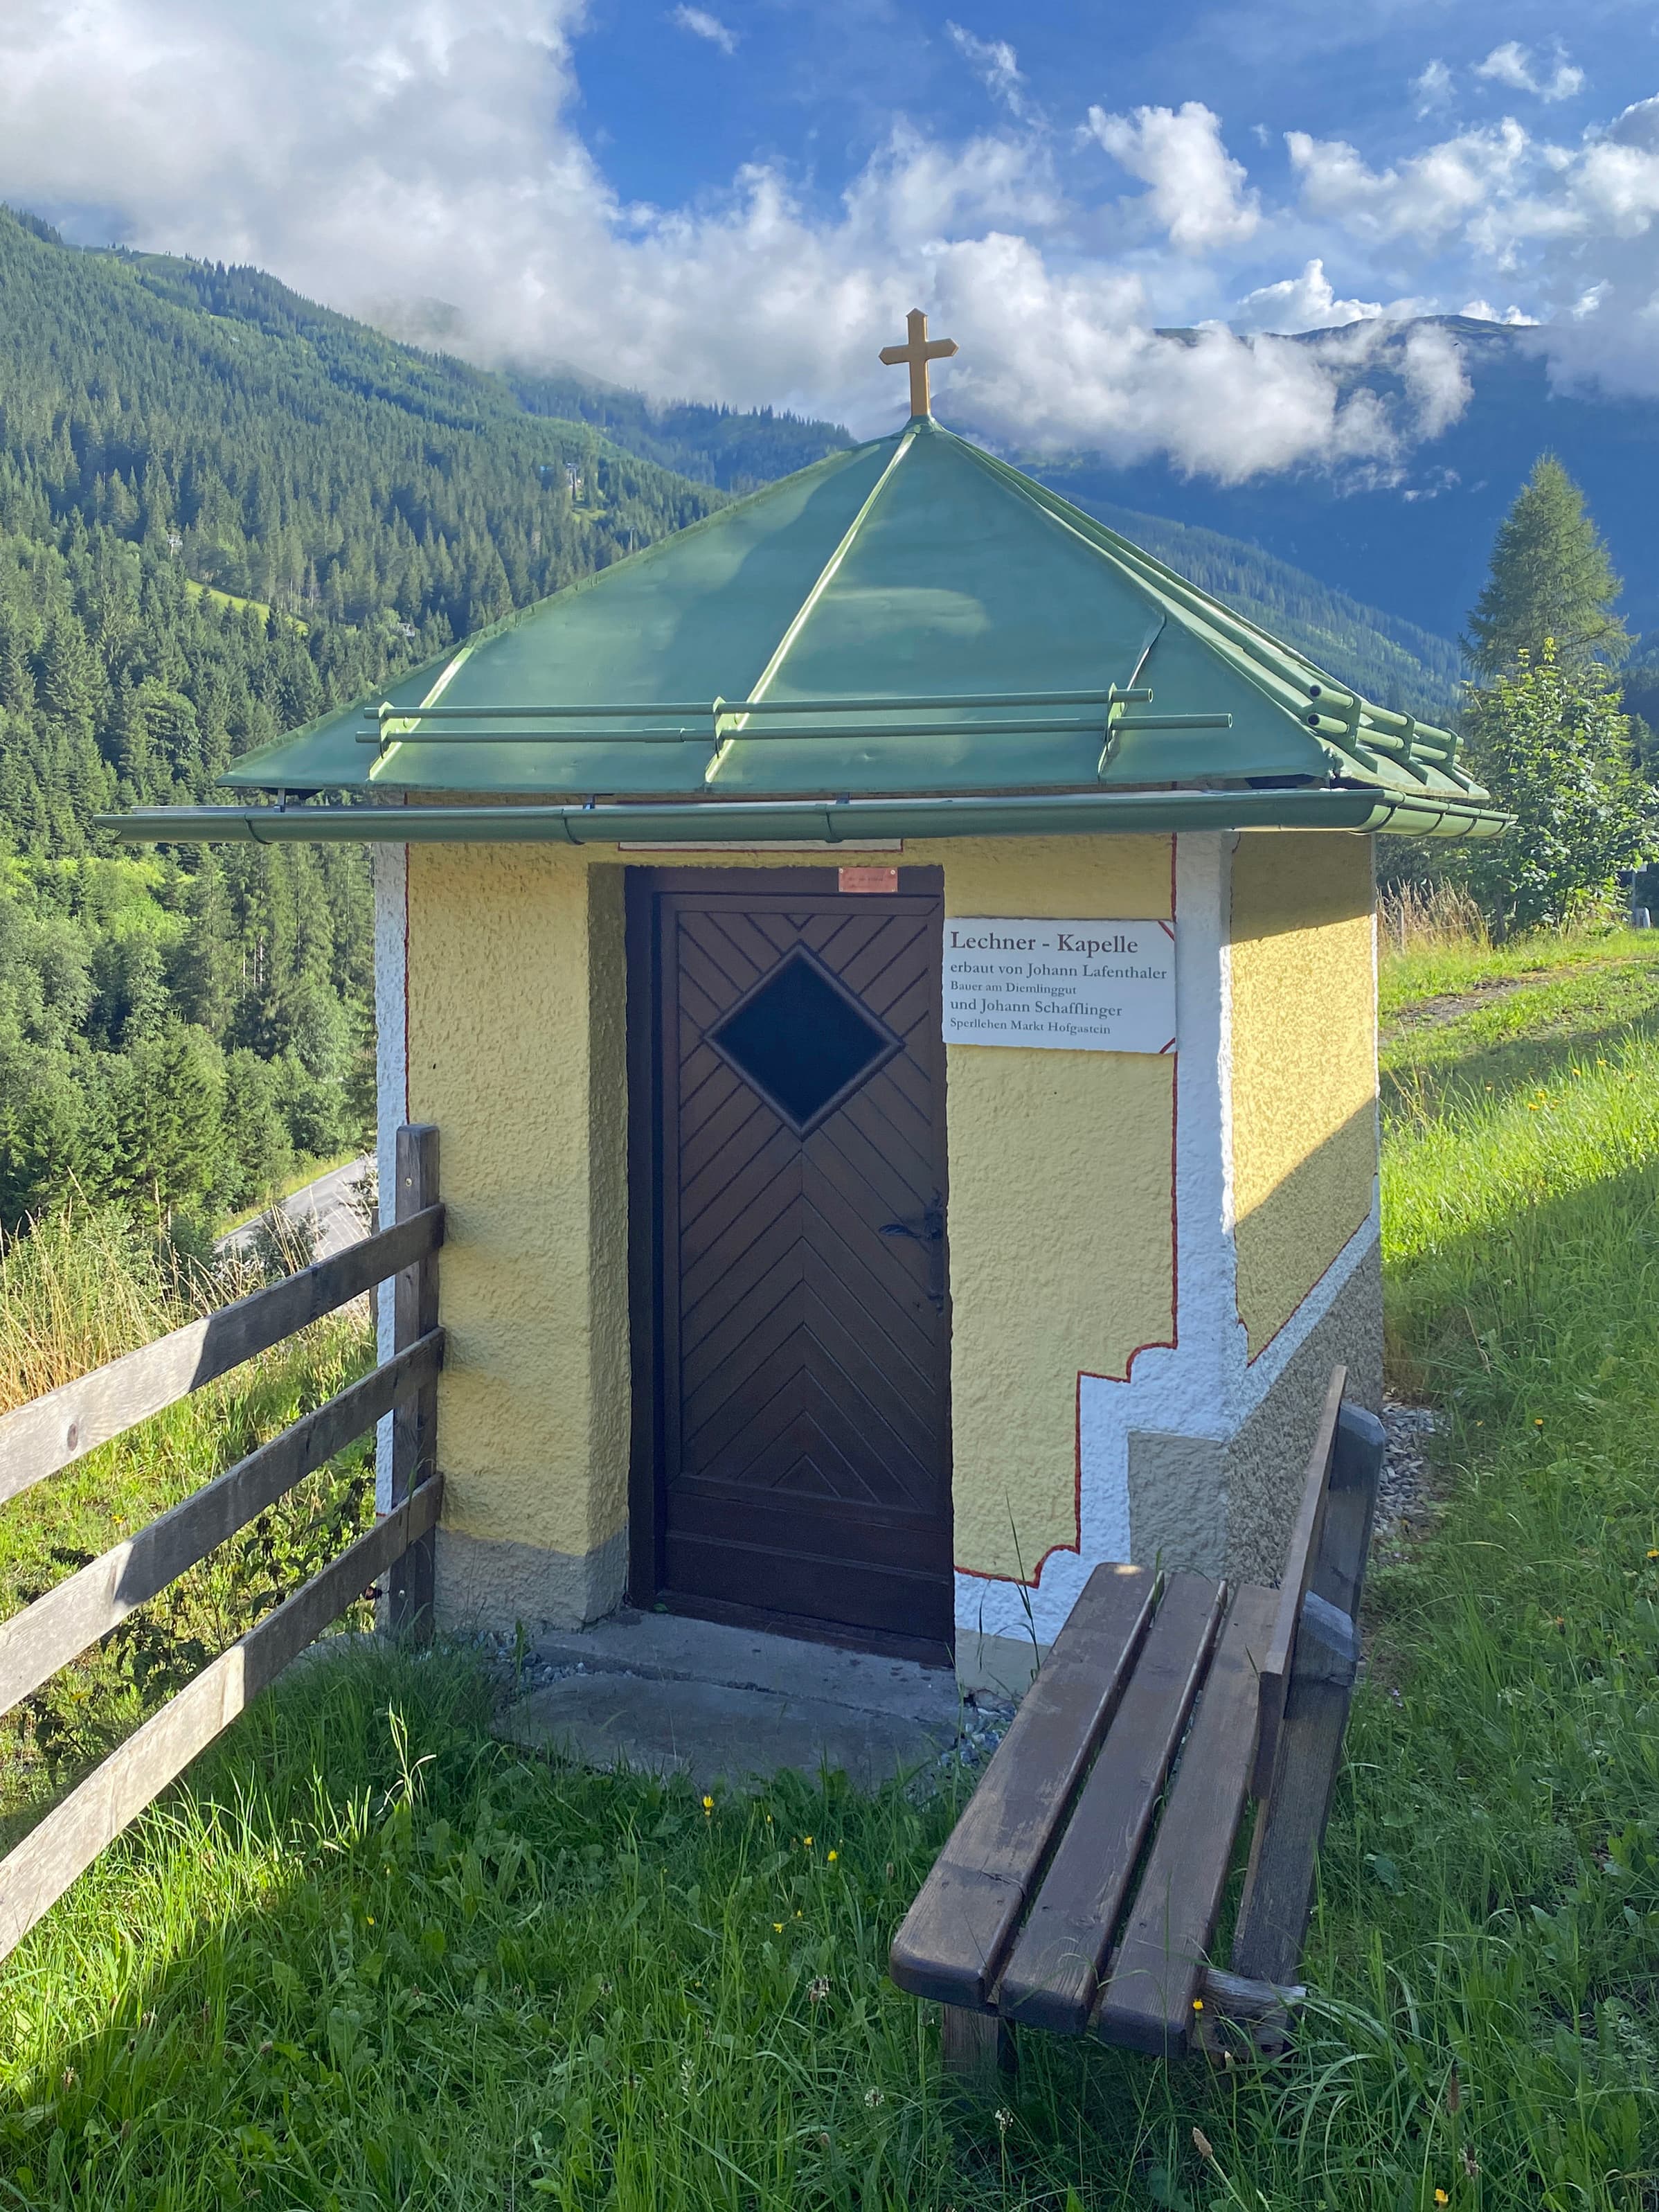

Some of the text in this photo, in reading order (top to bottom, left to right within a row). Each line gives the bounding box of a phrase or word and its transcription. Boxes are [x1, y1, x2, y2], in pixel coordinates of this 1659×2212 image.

[950, 931, 1036, 951] Lechner
[1057, 934, 1138, 958] Kapelle
[950, 962, 1167, 979] erbaut von Johann Lafenthaler
[951, 981, 983, 991] Bauer
[1006, 983, 1076, 997] Diemlinggut
[951, 999, 1122, 1019] und Johann Schafflinger
[1011, 1021, 1044, 1031] Markt
[1048, 1022, 1111, 1035] Hofgastein
